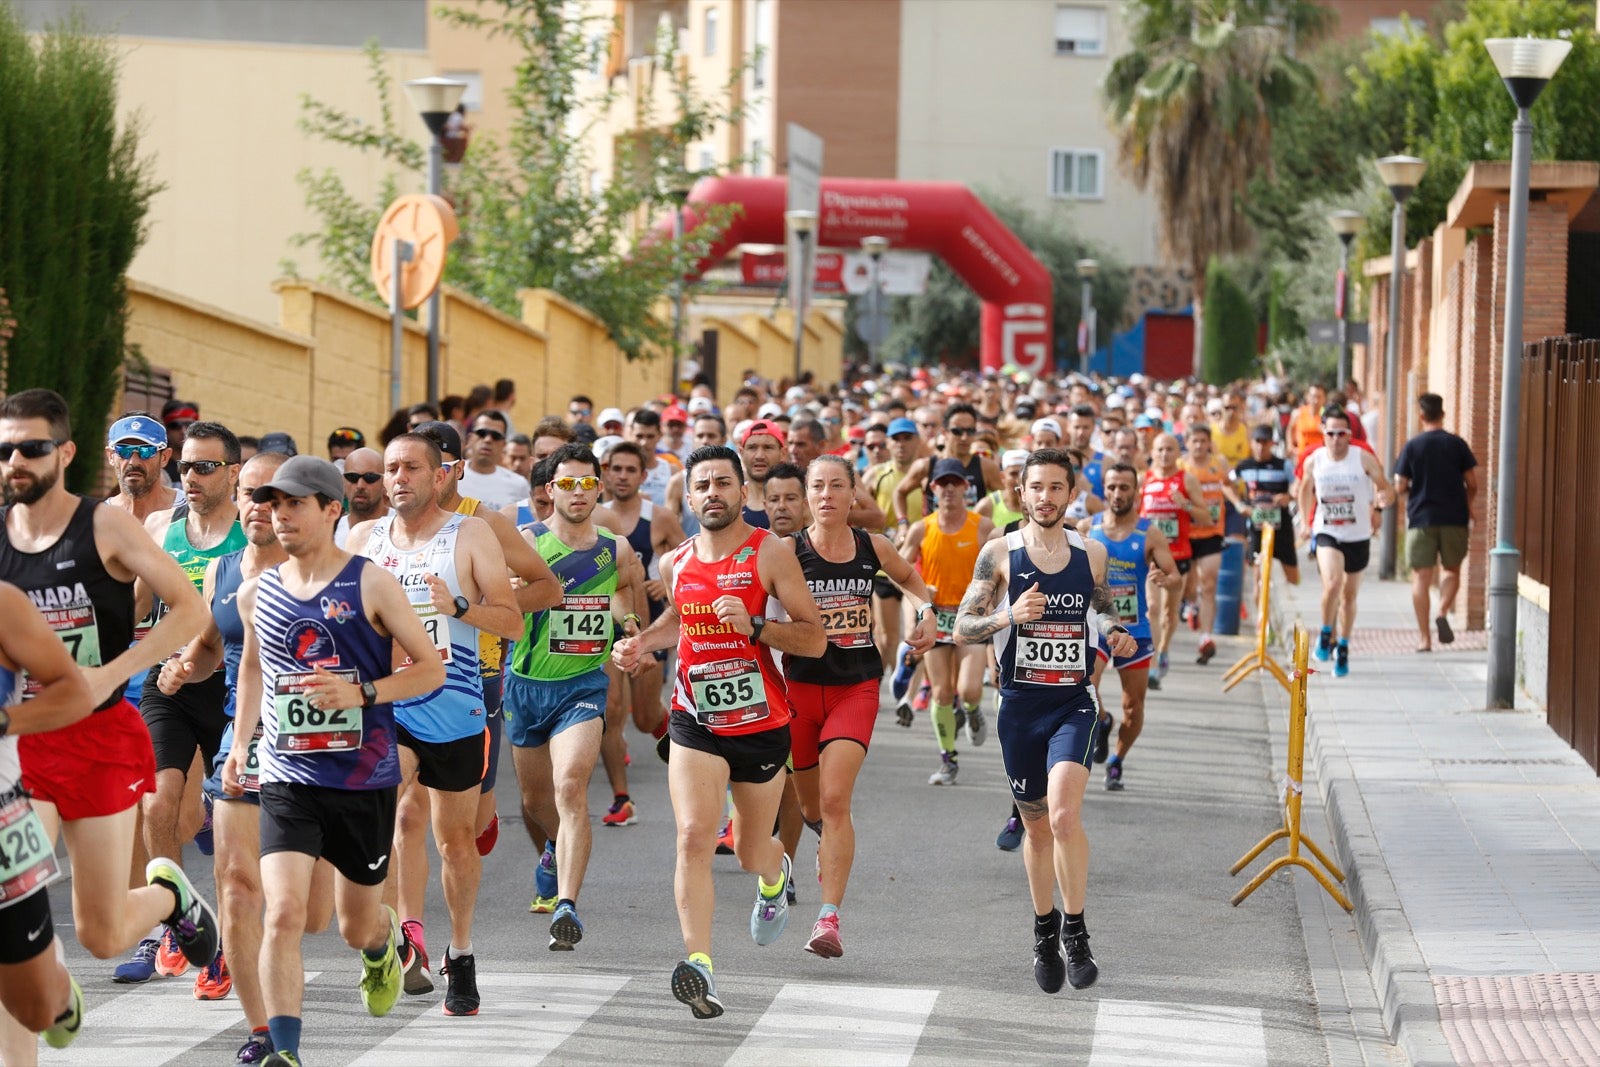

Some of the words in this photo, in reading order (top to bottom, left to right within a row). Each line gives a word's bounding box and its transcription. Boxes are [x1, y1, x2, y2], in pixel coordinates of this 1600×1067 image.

[717, 571, 752, 580] MotorDOS
[807, 579, 873, 592] GRANADA
[563, 614, 605, 636] 142
[820, 609, 867, 630] 2256
[1035, 624, 1047, 632] GRAN
[1047, 624, 1063, 632] PREMIO
[62, 633, 83, 662] 7
[1025, 641, 1080, 663] 3033
[715, 662, 733, 672] PREMIO
[733, 662, 740, 670] DE
[705, 677, 754, 707] 635
[287, 698, 348, 727] 682
